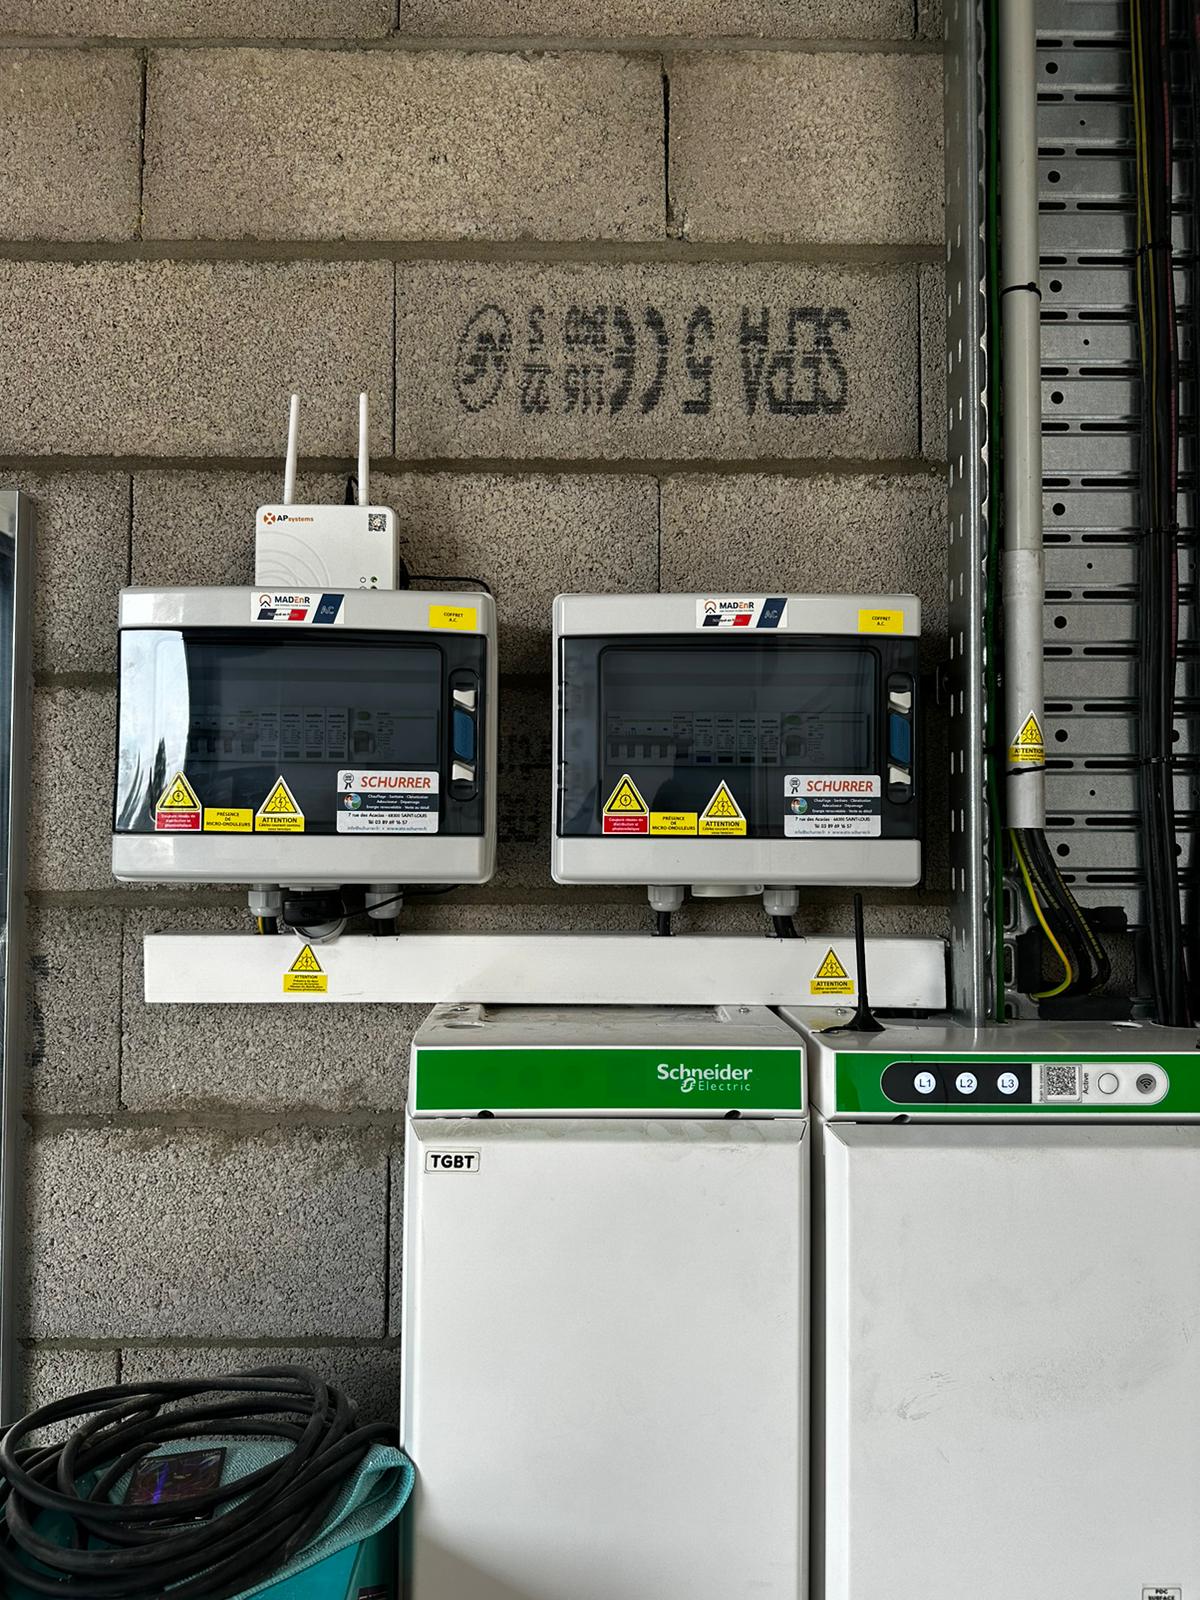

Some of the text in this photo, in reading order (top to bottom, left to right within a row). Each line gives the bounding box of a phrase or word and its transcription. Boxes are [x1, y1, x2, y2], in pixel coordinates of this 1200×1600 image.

[276, 514, 314, 523] APsystems
[361, 776, 431, 788] SCHURRER
[806, 780, 873, 792] SCHURRER
[657, 1063, 753, 1080] Schneider
[698, 1080, 751, 1091] Electric
[920, 1079, 931, 1088] L1
[960, 1079, 973, 1088] L2
[1002, 1079, 1015, 1088] L3
[430, 1154, 475, 1169] TGBT
